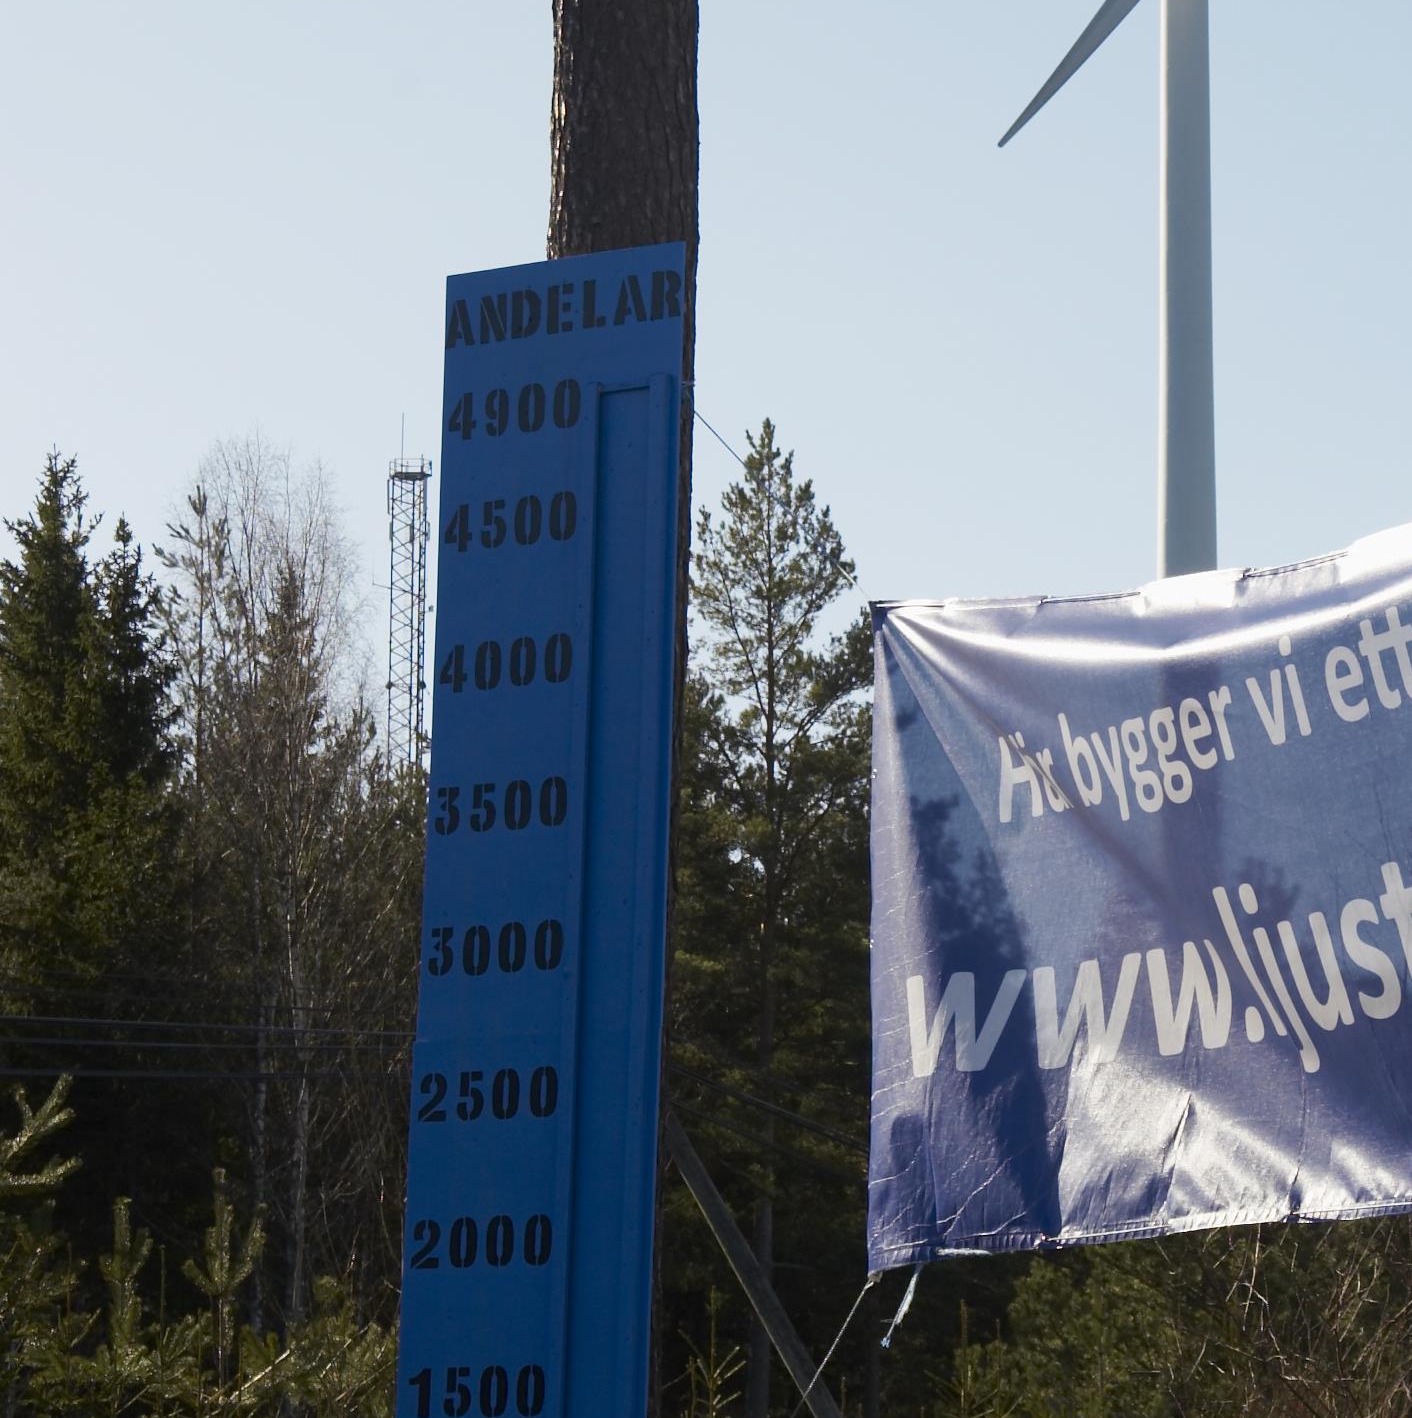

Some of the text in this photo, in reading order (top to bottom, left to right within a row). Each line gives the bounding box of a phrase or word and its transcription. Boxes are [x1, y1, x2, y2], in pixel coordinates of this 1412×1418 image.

[445, 270, 682, 349] ANDELAR
[448, 378, 581, 441] 4900
[444, 491, 578, 553] 4500
[439, 633, 573, 693] 4000
[1057, 685, 1236, 822] bygger
[1245, 635, 1313, 745] vi
[434, 776, 569, 836] 3500
[427, 919, 564, 977] 3000
[418, 1065, 559, 1123] 2500
[411, 1215, 553, 1270] 2000
